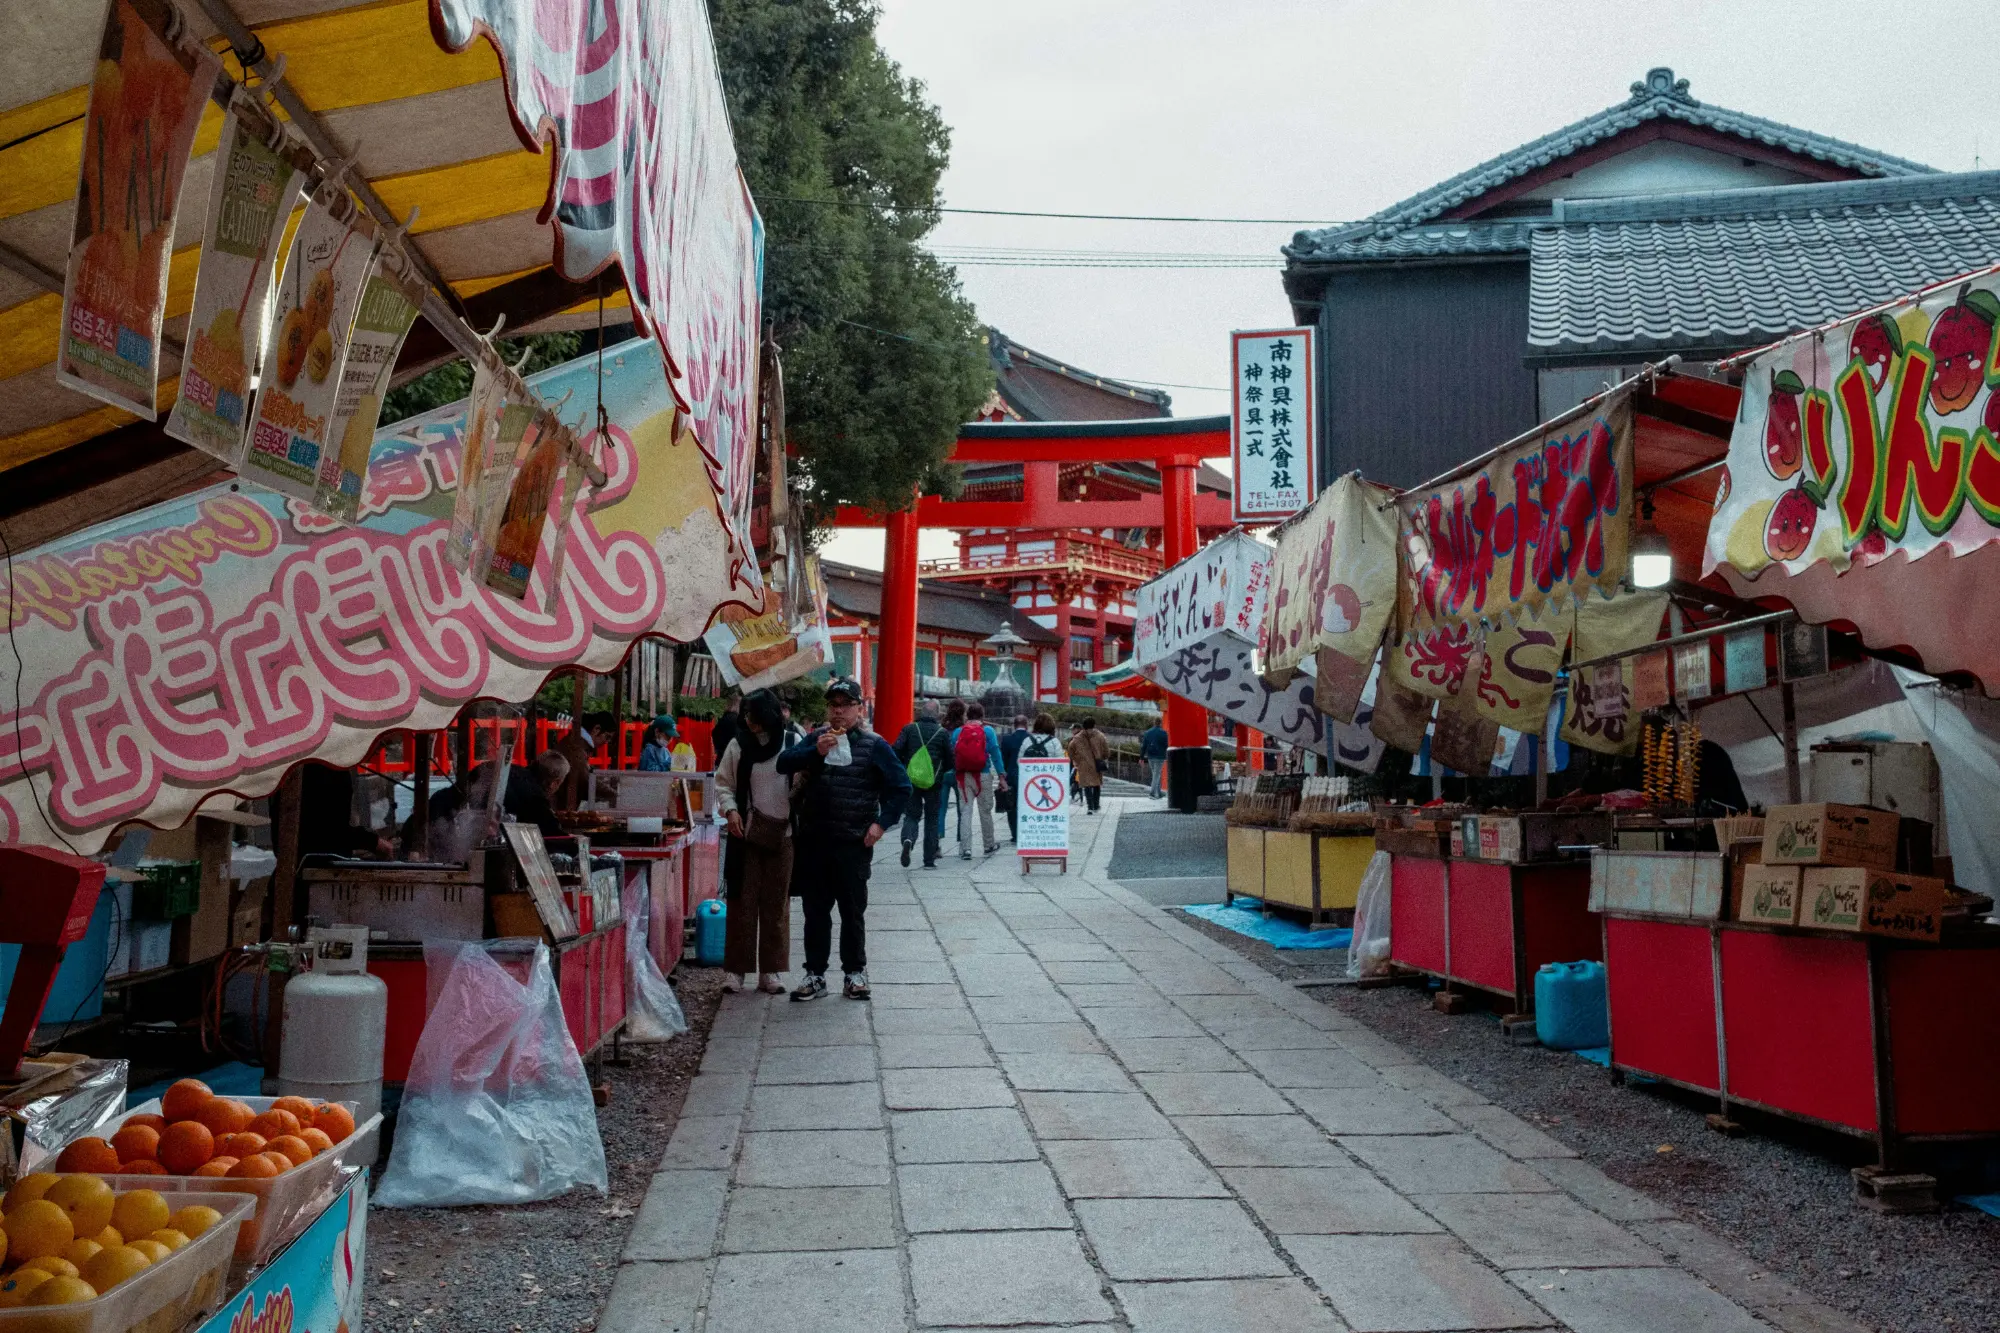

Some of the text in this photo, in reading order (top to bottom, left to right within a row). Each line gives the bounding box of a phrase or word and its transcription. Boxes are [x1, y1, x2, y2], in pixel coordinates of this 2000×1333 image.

[1244, 362, 1264, 457] 神祭具一式
[1269, 339, 1294, 489] 南神具株式會社
[1024, 764, 1065, 772] これより先
[1020, 814, 1065, 823] 食べ歩き禁止
